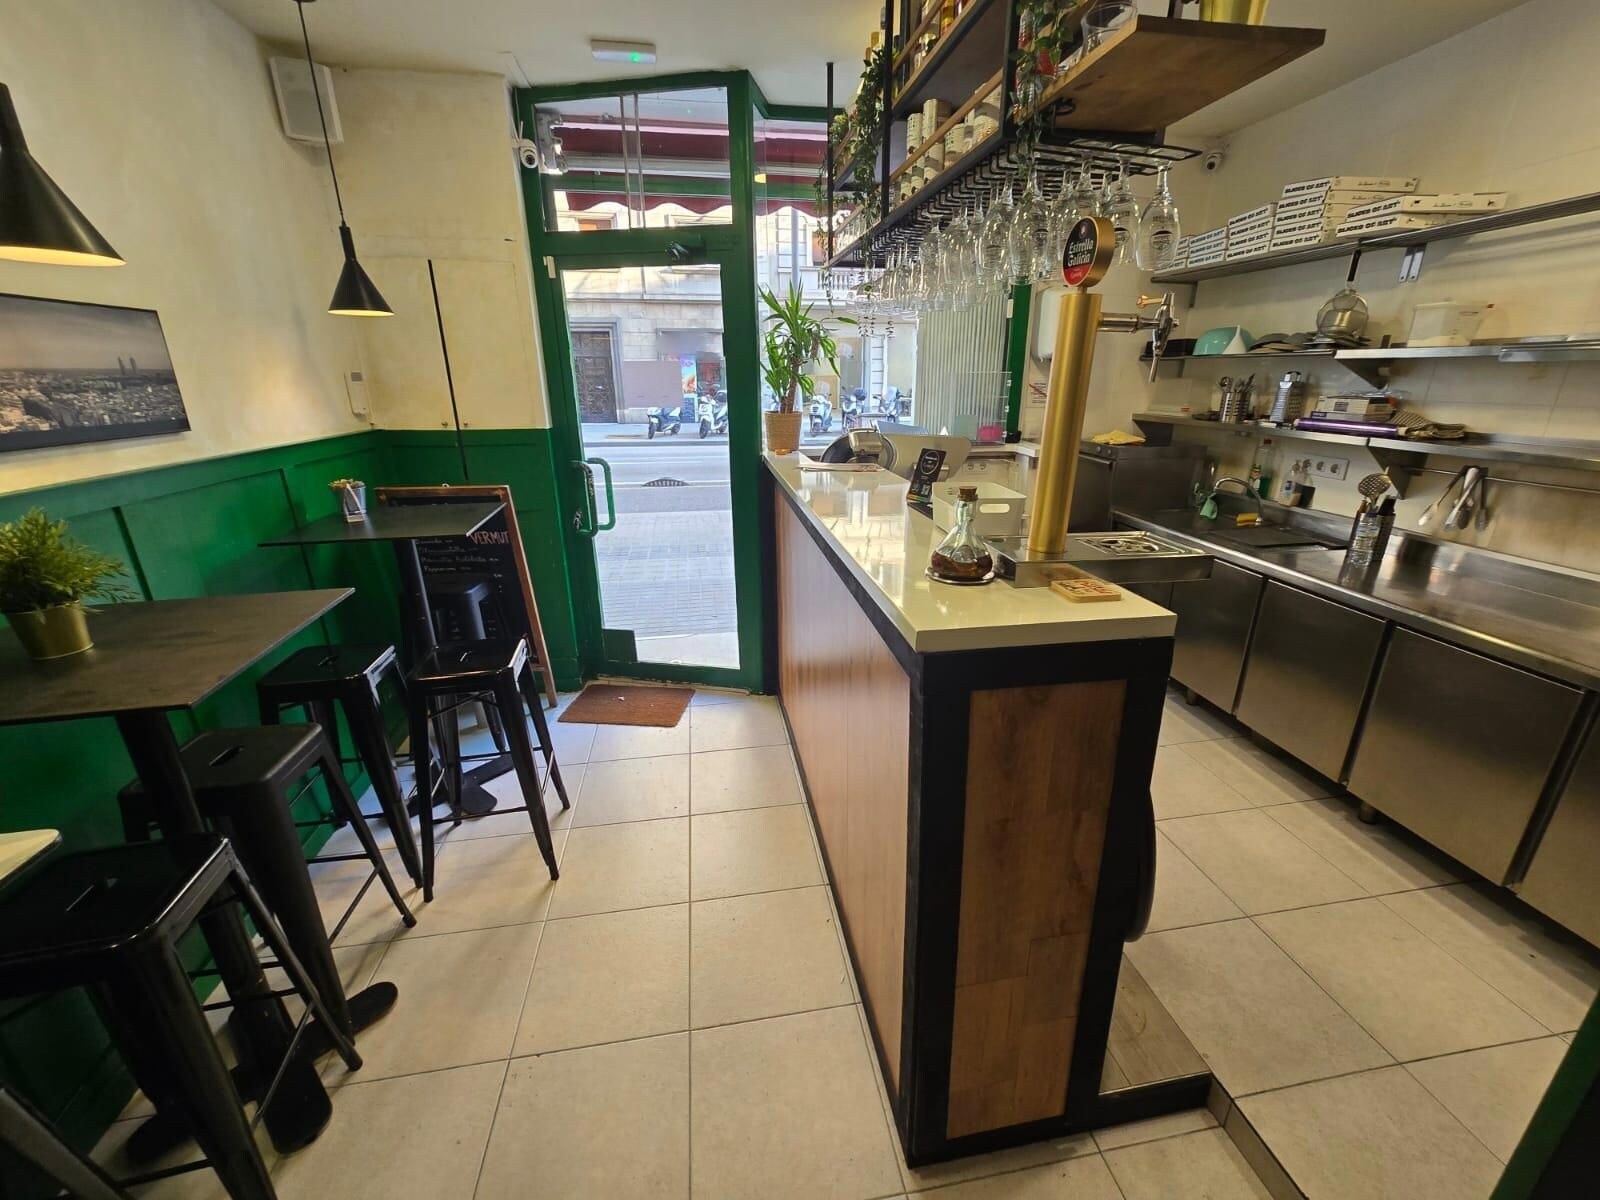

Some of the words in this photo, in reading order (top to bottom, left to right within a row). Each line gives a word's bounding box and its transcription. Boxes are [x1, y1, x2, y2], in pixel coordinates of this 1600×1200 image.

[1069, 239, 1094, 254] Estrella
[1067, 252, 1091, 267] Galicia
[470, 531, 510, 544] VERMUT
